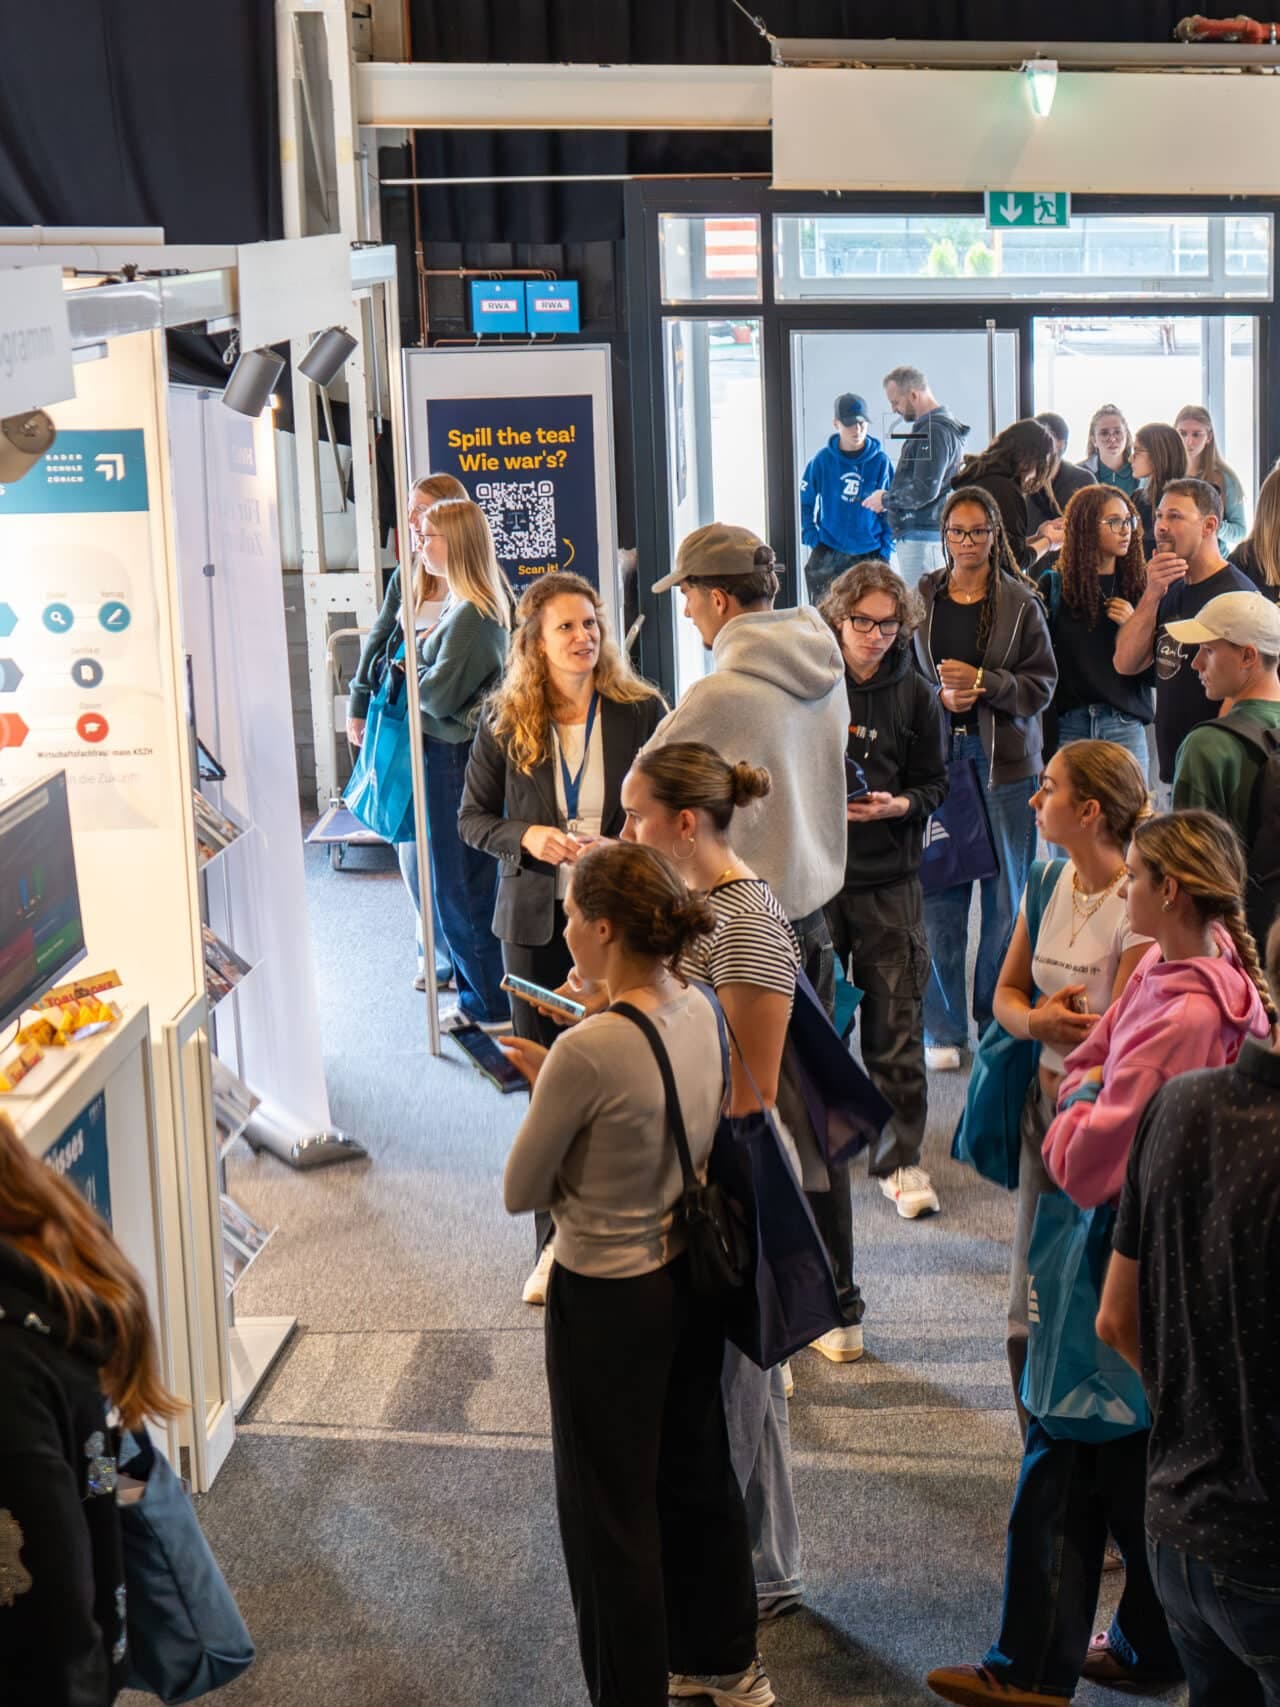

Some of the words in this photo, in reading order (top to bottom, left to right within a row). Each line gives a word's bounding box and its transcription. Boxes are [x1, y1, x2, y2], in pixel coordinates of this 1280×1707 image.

[541, 301, 563, 309] RWA
[447, 427, 492, 452] Spill
[496, 426, 532, 445] the
[536, 424, 576, 444] tea!
[458, 452, 499, 472] Wie
[503, 449, 568, 470] war's?
[518, 564, 545, 575] Scan
[547, 562, 559, 573] it!
